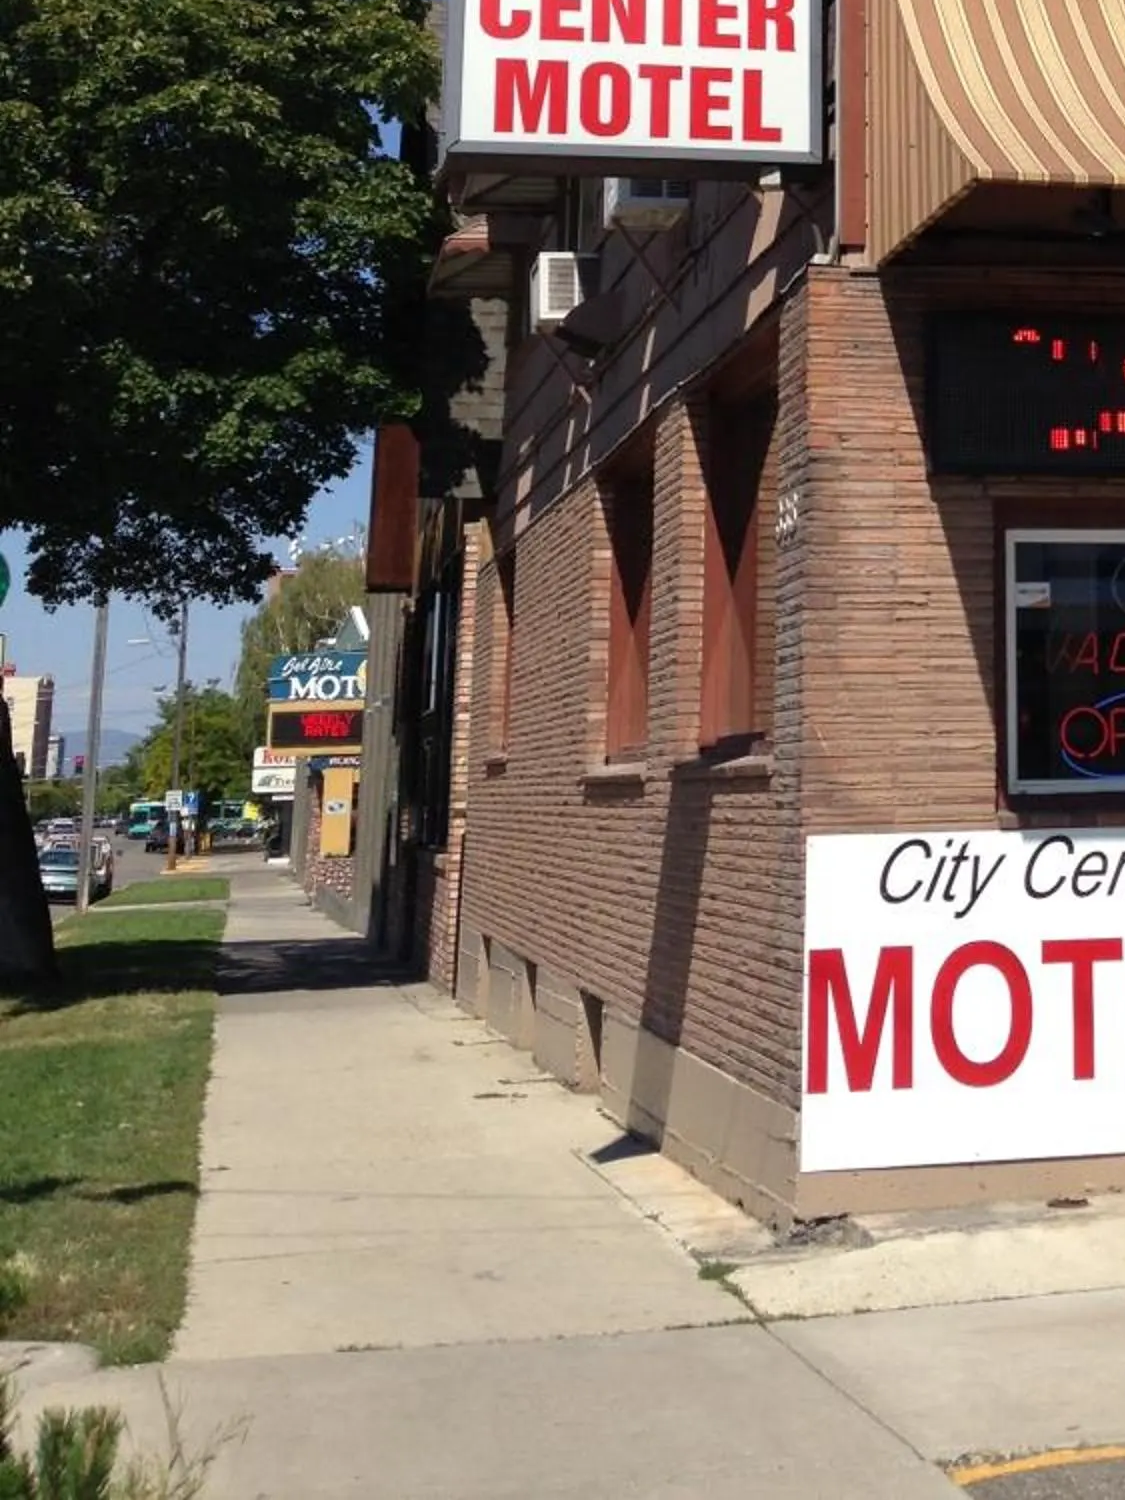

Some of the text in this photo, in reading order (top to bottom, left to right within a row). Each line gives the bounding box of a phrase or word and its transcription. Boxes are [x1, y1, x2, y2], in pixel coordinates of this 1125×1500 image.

[493, 57, 783, 143] MOTEL
[288, 675, 366, 700] MOT
[878, 838, 1006, 919] City
